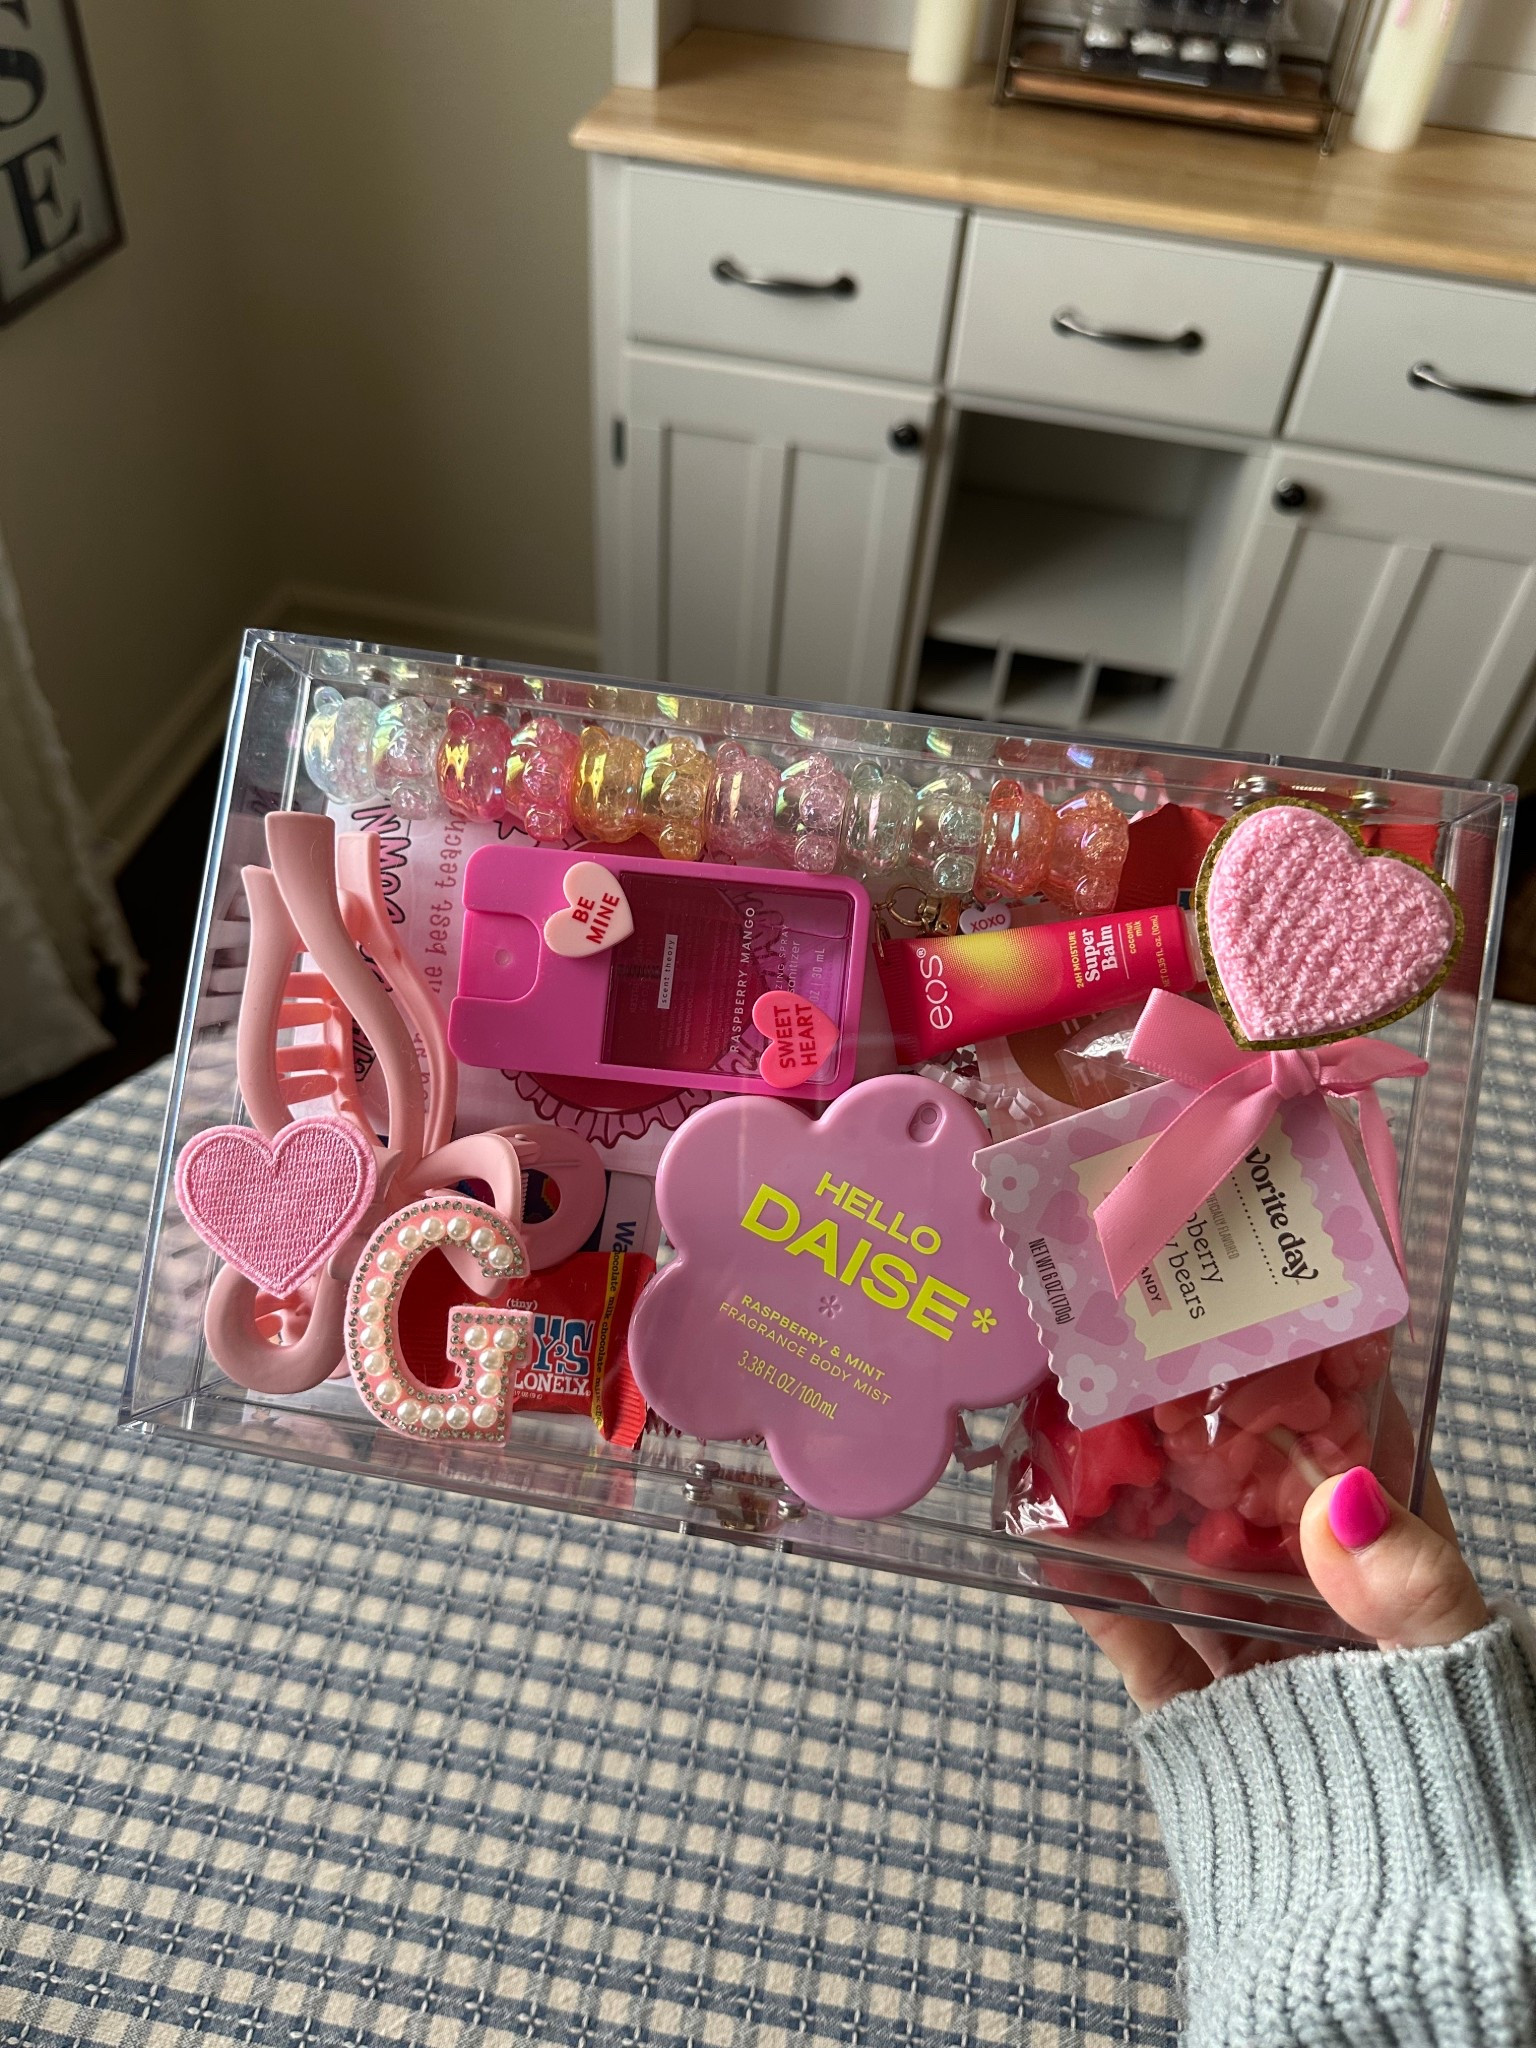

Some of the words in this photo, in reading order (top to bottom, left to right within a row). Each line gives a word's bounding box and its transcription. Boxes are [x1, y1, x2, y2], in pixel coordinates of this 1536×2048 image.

[571, 896, 595, 924] BE
[585, 893, 620, 944] MINE
[969, 912, 1007, 933] XOXO
[428, 901, 453, 958] best
[778, 924, 790, 958] SPRAY
[1124, 921, 1137, 955] coconut
[1132, 919, 1143, 937] milk
[665, 938, 676, 974] theory
[814, 947, 826, 963] mL
[1067, 930, 1081, 972] MOISTURE
[1081, 928, 1101, 983] Super
[1096, 924, 1118, 971] Balm
[660, 976, 674, 1004] scent
[729, 969, 748, 1053] RASPBERRY
[742, 906, 756, 965] MANGO
[811, 967, 823, 979] 30
[1074, 971, 1085, 989] 24H
[1160, 975, 1171, 988] NET
[773, 1005, 797, 1069] SWEET
[795, 1003, 818, 1067] HEART
[814, 1171, 942, 1256] HELLO
[1245, 1146, 1289, 1231] vorite
[1277, 1231, 1319, 1280] day
[613, 1220, 637, 1253] Wa
[1028, 1237, 1047, 1256] NET
[1186, 1212, 1224, 1283] berry
[1216, 1225, 1240, 1261] FLAVORED
[1035, 1256, 1052, 1274] WT
[1041, 1273, 1053, 1282] 6
[1044, 1280, 1064, 1294] OZ
[1140, 1266, 1162, 1302] ANDY
[1168, 1250, 1206, 1320] bears
[506, 1297, 538, 1312] (tiny)
[604, 1294, 616, 1321] milk
[1047, 1291, 1076, 1325] (170g)
[532, 1312, 596, 1377] Y'S
[597, 1321, 610, 1373] chocolate
[719, 1301, 808, 1358] FRAGRANCE
[809, 1353, 852, 1382] BODY
[853, 1378, 892, 1405] MIST
[741, 1294, 828, 1349] RASPBERRY
[829, 1345, 842, 1358] &
[844, 1353, 886, 1382] MINT
[737, 1350, 766, 1377] 3.38
